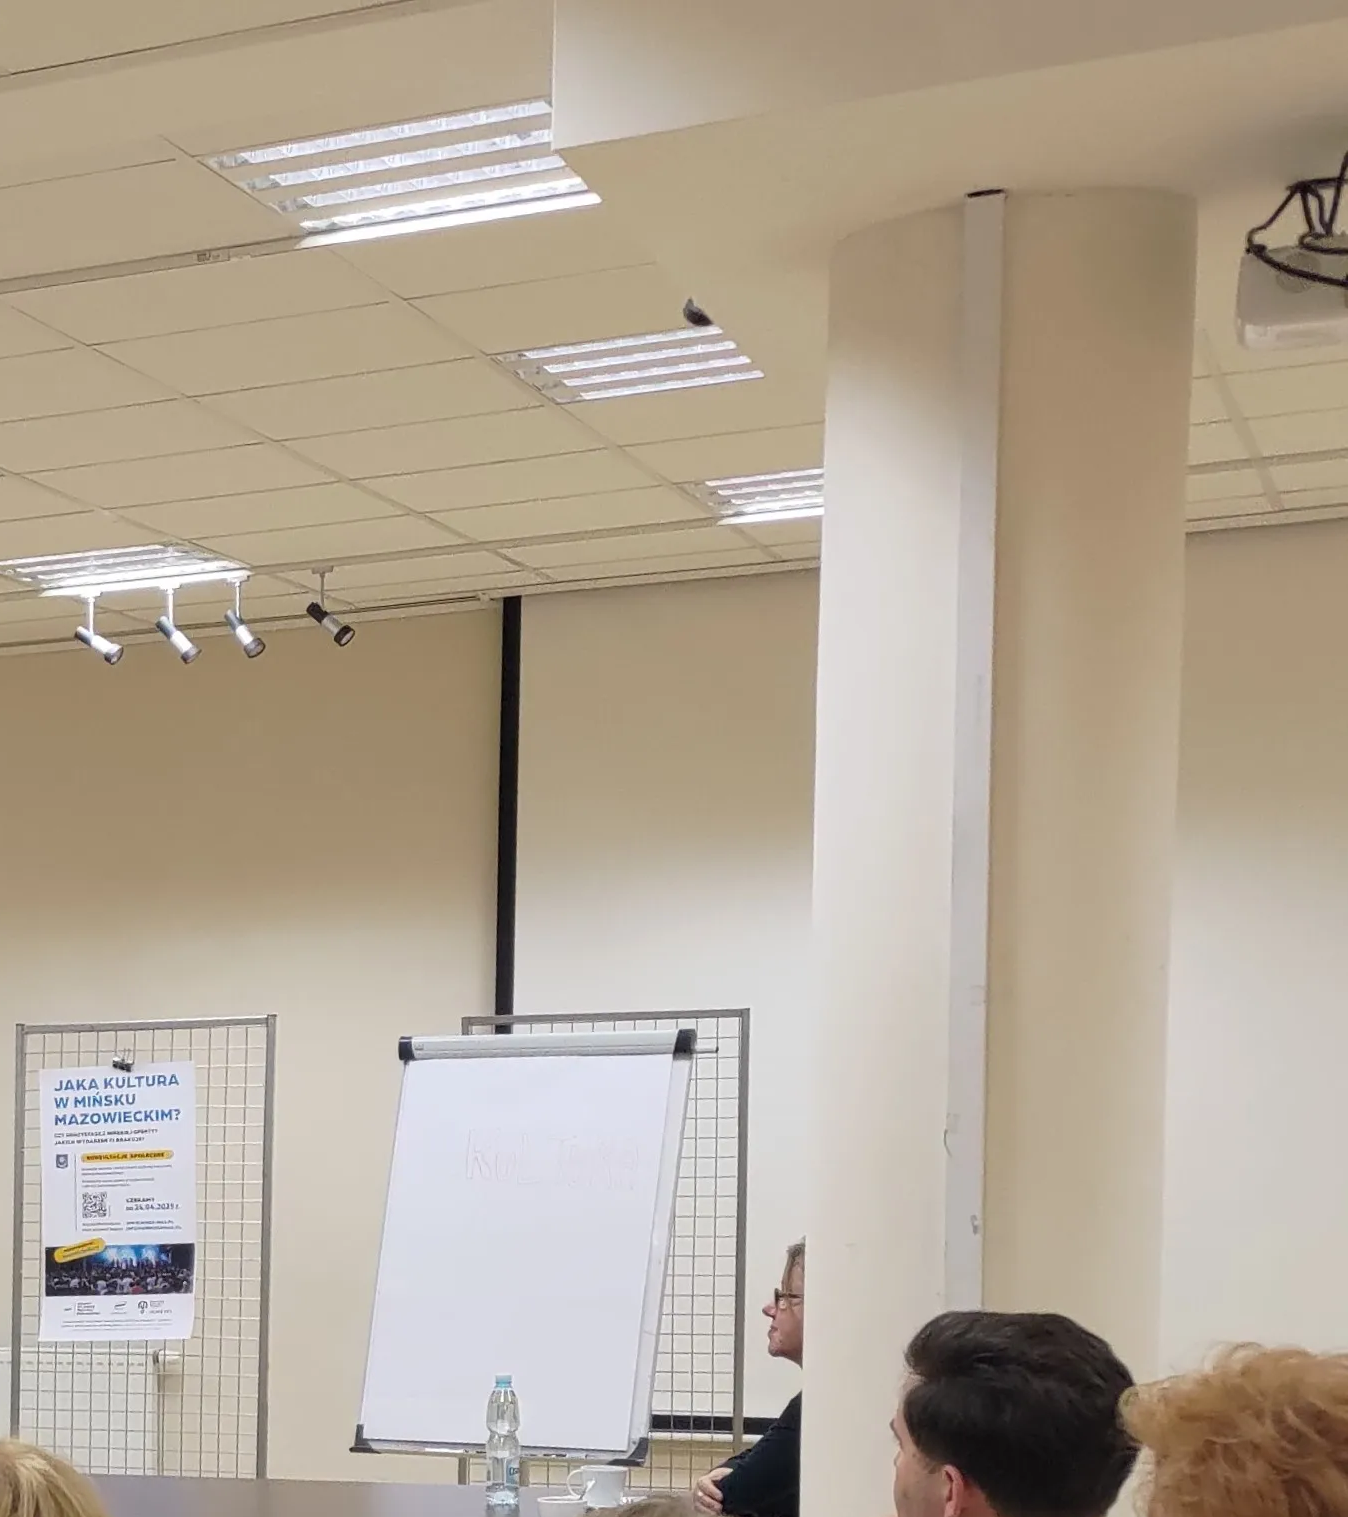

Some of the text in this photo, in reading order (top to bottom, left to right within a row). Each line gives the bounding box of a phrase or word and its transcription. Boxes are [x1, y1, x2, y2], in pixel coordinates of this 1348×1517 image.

[54, 1073, 180, 1092] JAKA KULTURA
[54, 1091, 136, 1109] W MIŃSKU
[54, 1108, 181, 1126] MAZOWIECKIM?
[466, 1127, 640, 1190] KULT
